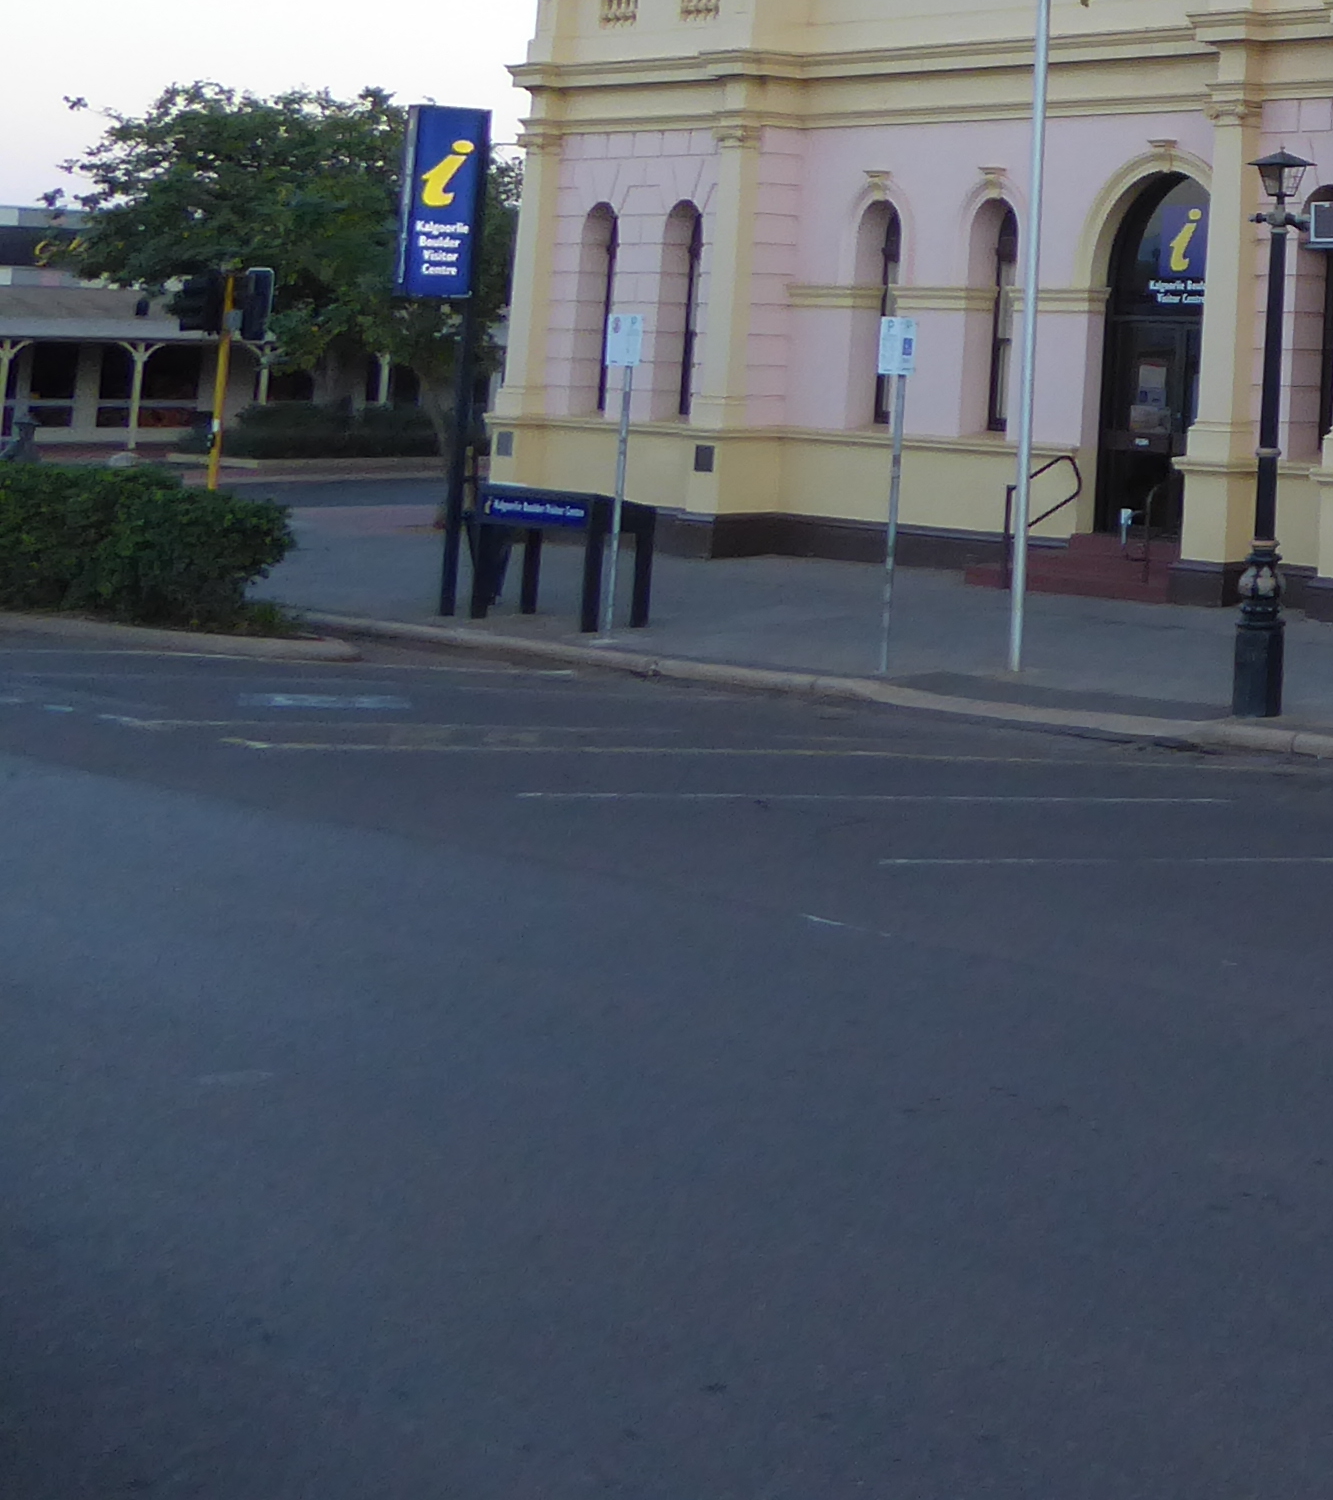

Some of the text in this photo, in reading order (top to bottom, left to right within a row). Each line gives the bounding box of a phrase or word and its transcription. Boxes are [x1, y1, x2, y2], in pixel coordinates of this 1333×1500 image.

[415, 220, 470, 236] Kalgoorlie
[418, 235, 462, 249] Boulder
[422, 250, 460, 263] Visitor
[421, 263, 458, 276] Centre
